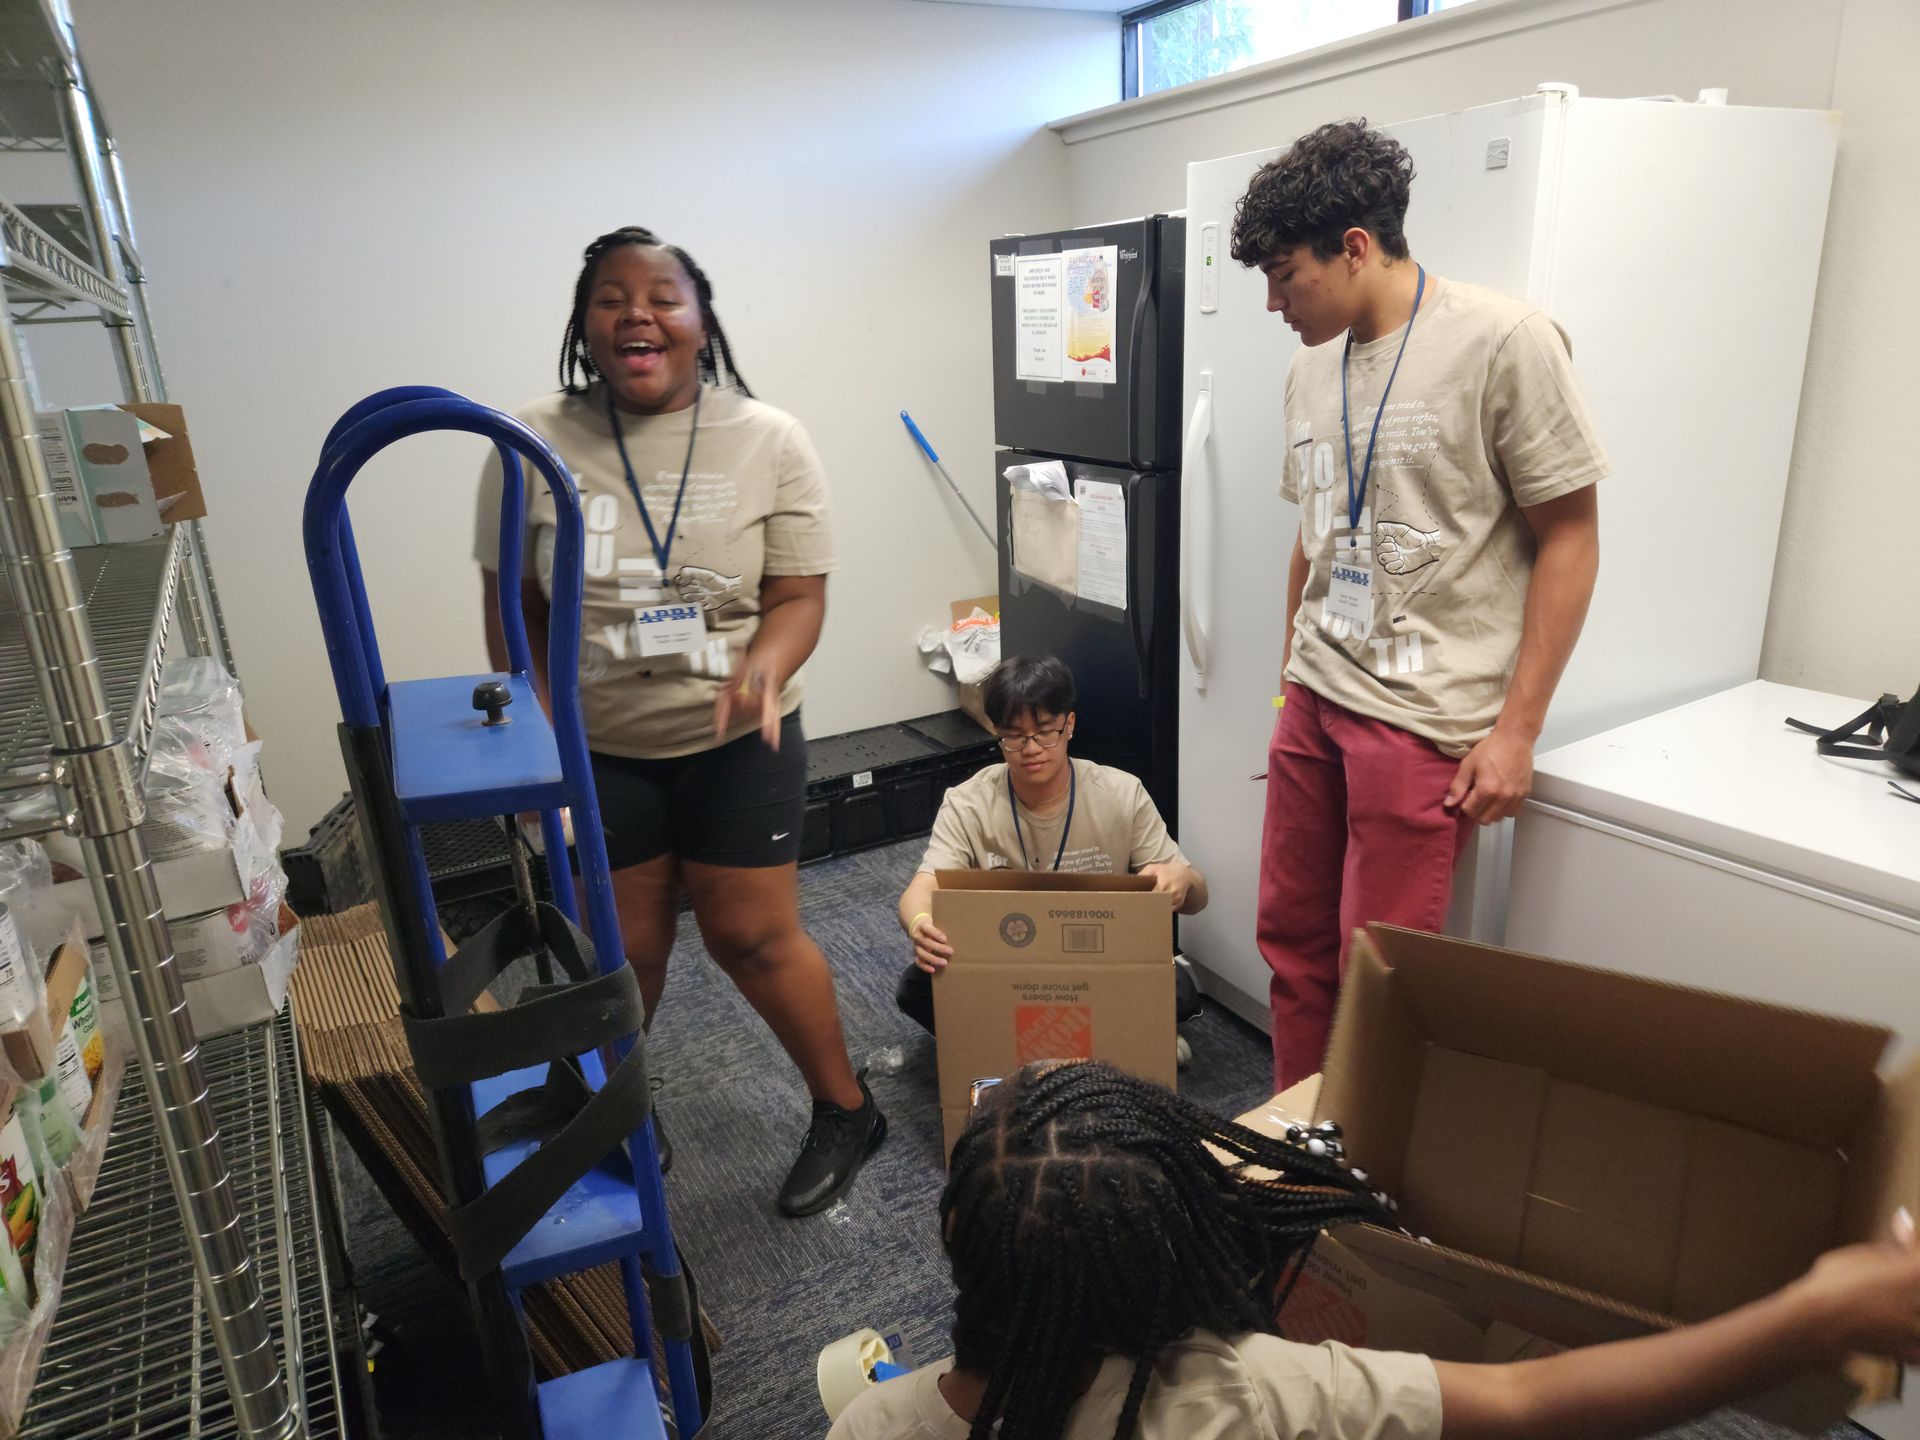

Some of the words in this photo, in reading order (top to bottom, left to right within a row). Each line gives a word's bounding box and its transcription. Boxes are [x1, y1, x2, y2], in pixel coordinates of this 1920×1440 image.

[1048, 910, 1114, 918] 1006188665
[1042, 983, 1069, 991] more
[1072, 983, 1089, 991] get
[1022, 994, 1052, 1002] doers
[1056, 994, 1078, 1002] How
